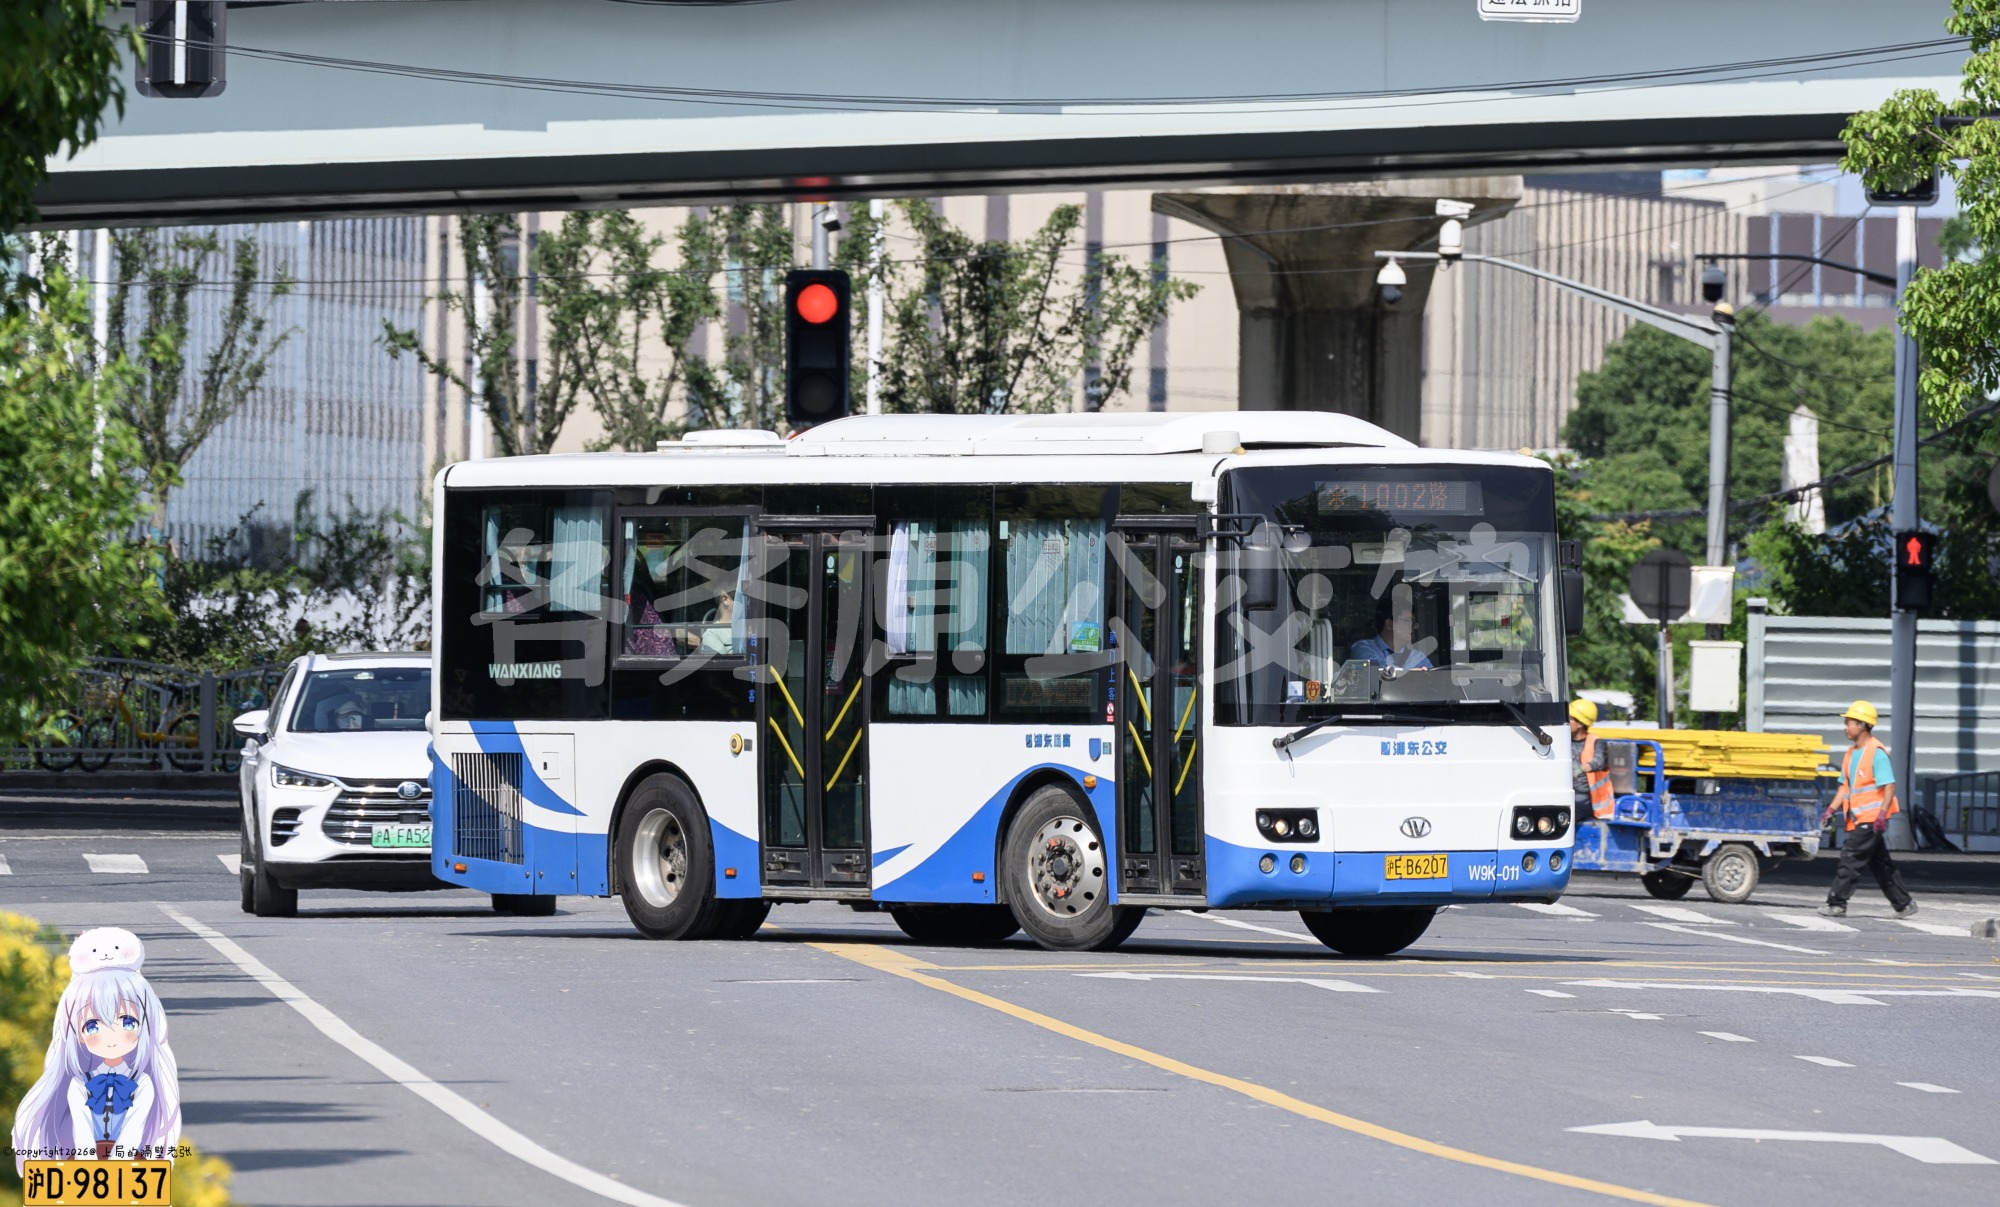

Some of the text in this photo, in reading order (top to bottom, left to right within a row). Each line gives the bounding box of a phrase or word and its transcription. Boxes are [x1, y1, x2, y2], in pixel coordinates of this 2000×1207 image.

[488, 663, 561, 679] WANXIANG
[1393, 741, 1447, 755] 浦东公交
[1468, 865, 1520, 881] W9K-011
